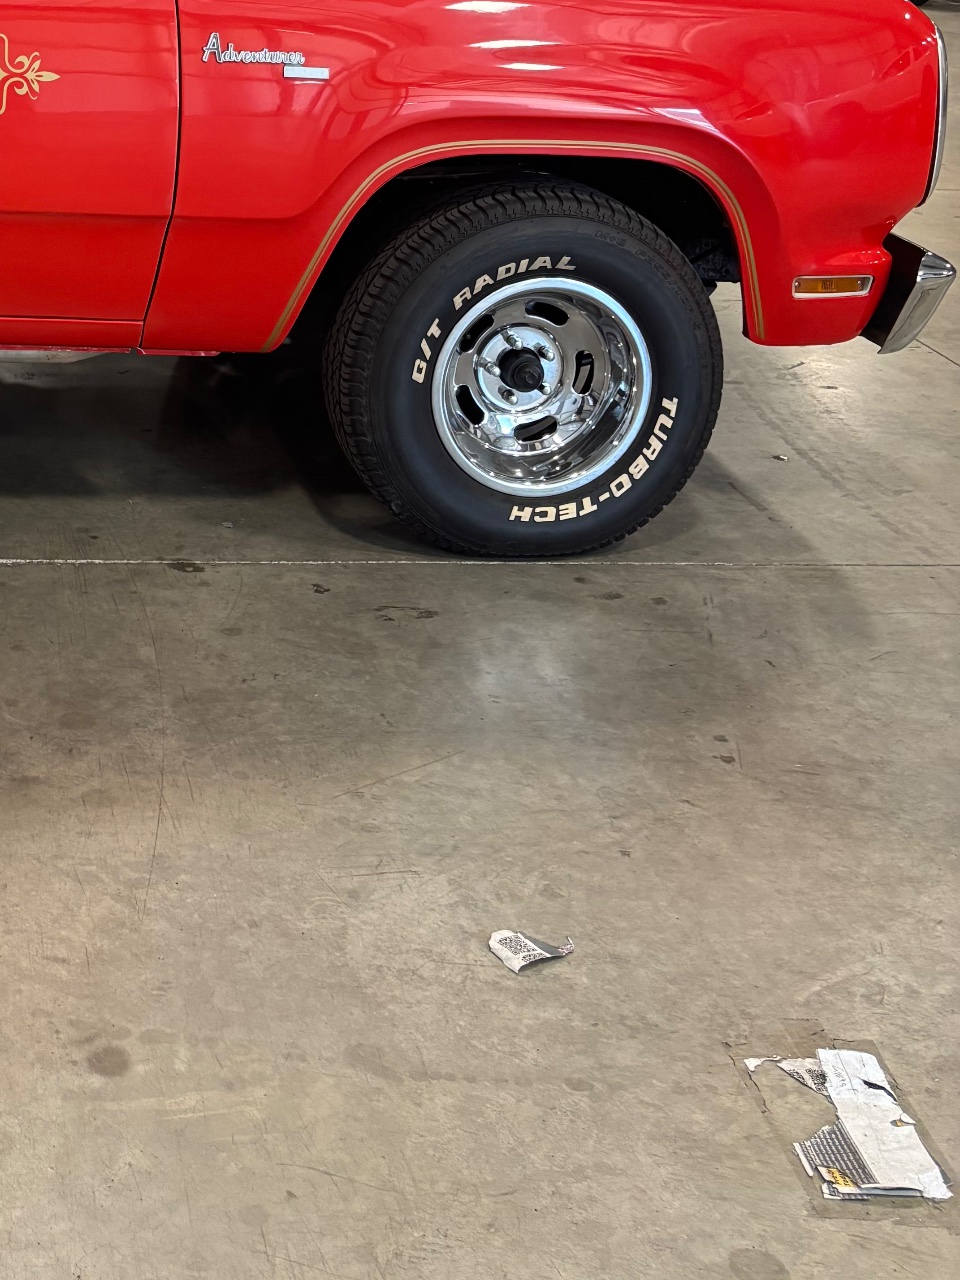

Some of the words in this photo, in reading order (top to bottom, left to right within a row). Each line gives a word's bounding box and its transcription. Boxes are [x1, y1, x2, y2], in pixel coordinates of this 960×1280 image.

[202, 32, 305, 64] Adventurer
[411, 317, 443, 384] G/T
[452, 255, 577, 311] RADIAL
[508, 396, 679, 522] TURBO-TECH
